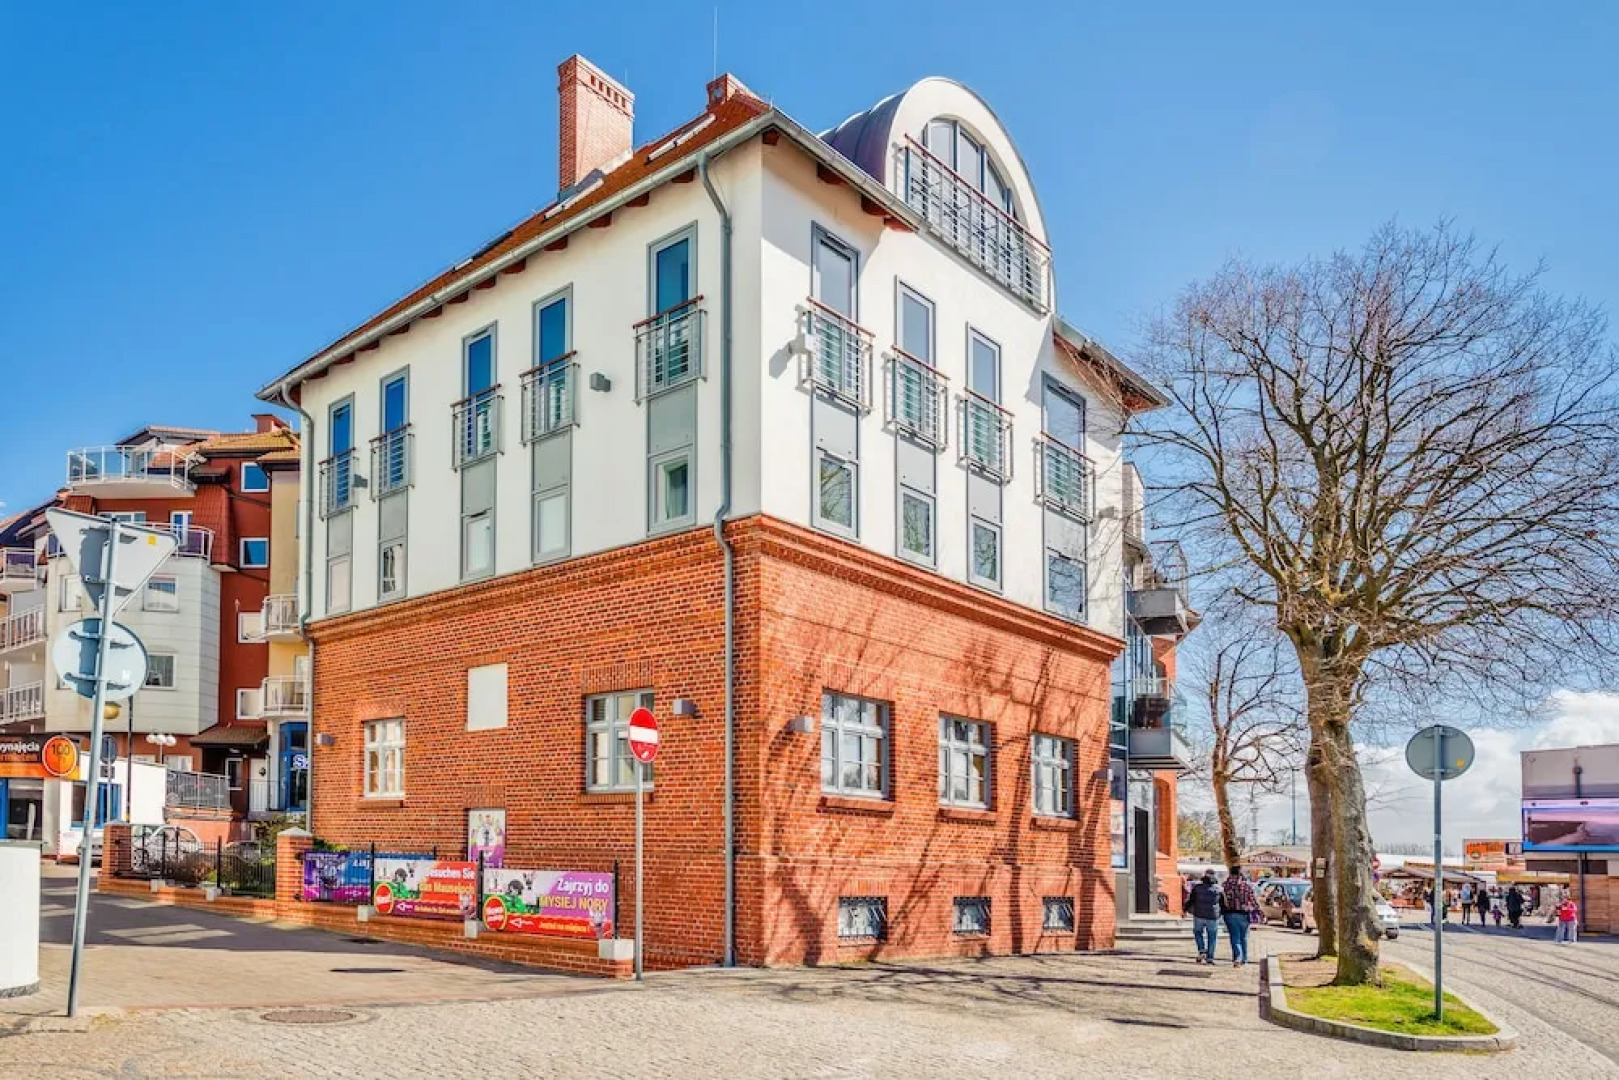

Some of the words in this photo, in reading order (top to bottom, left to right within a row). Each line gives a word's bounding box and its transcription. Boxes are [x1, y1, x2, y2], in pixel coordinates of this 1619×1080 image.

[557, 877, 593, 895] Zajrzyj
[595, 878, 610, 893] do
[539, 894, 577, 909] MYSIEJ
[580, 897, 608, 911] NORY
